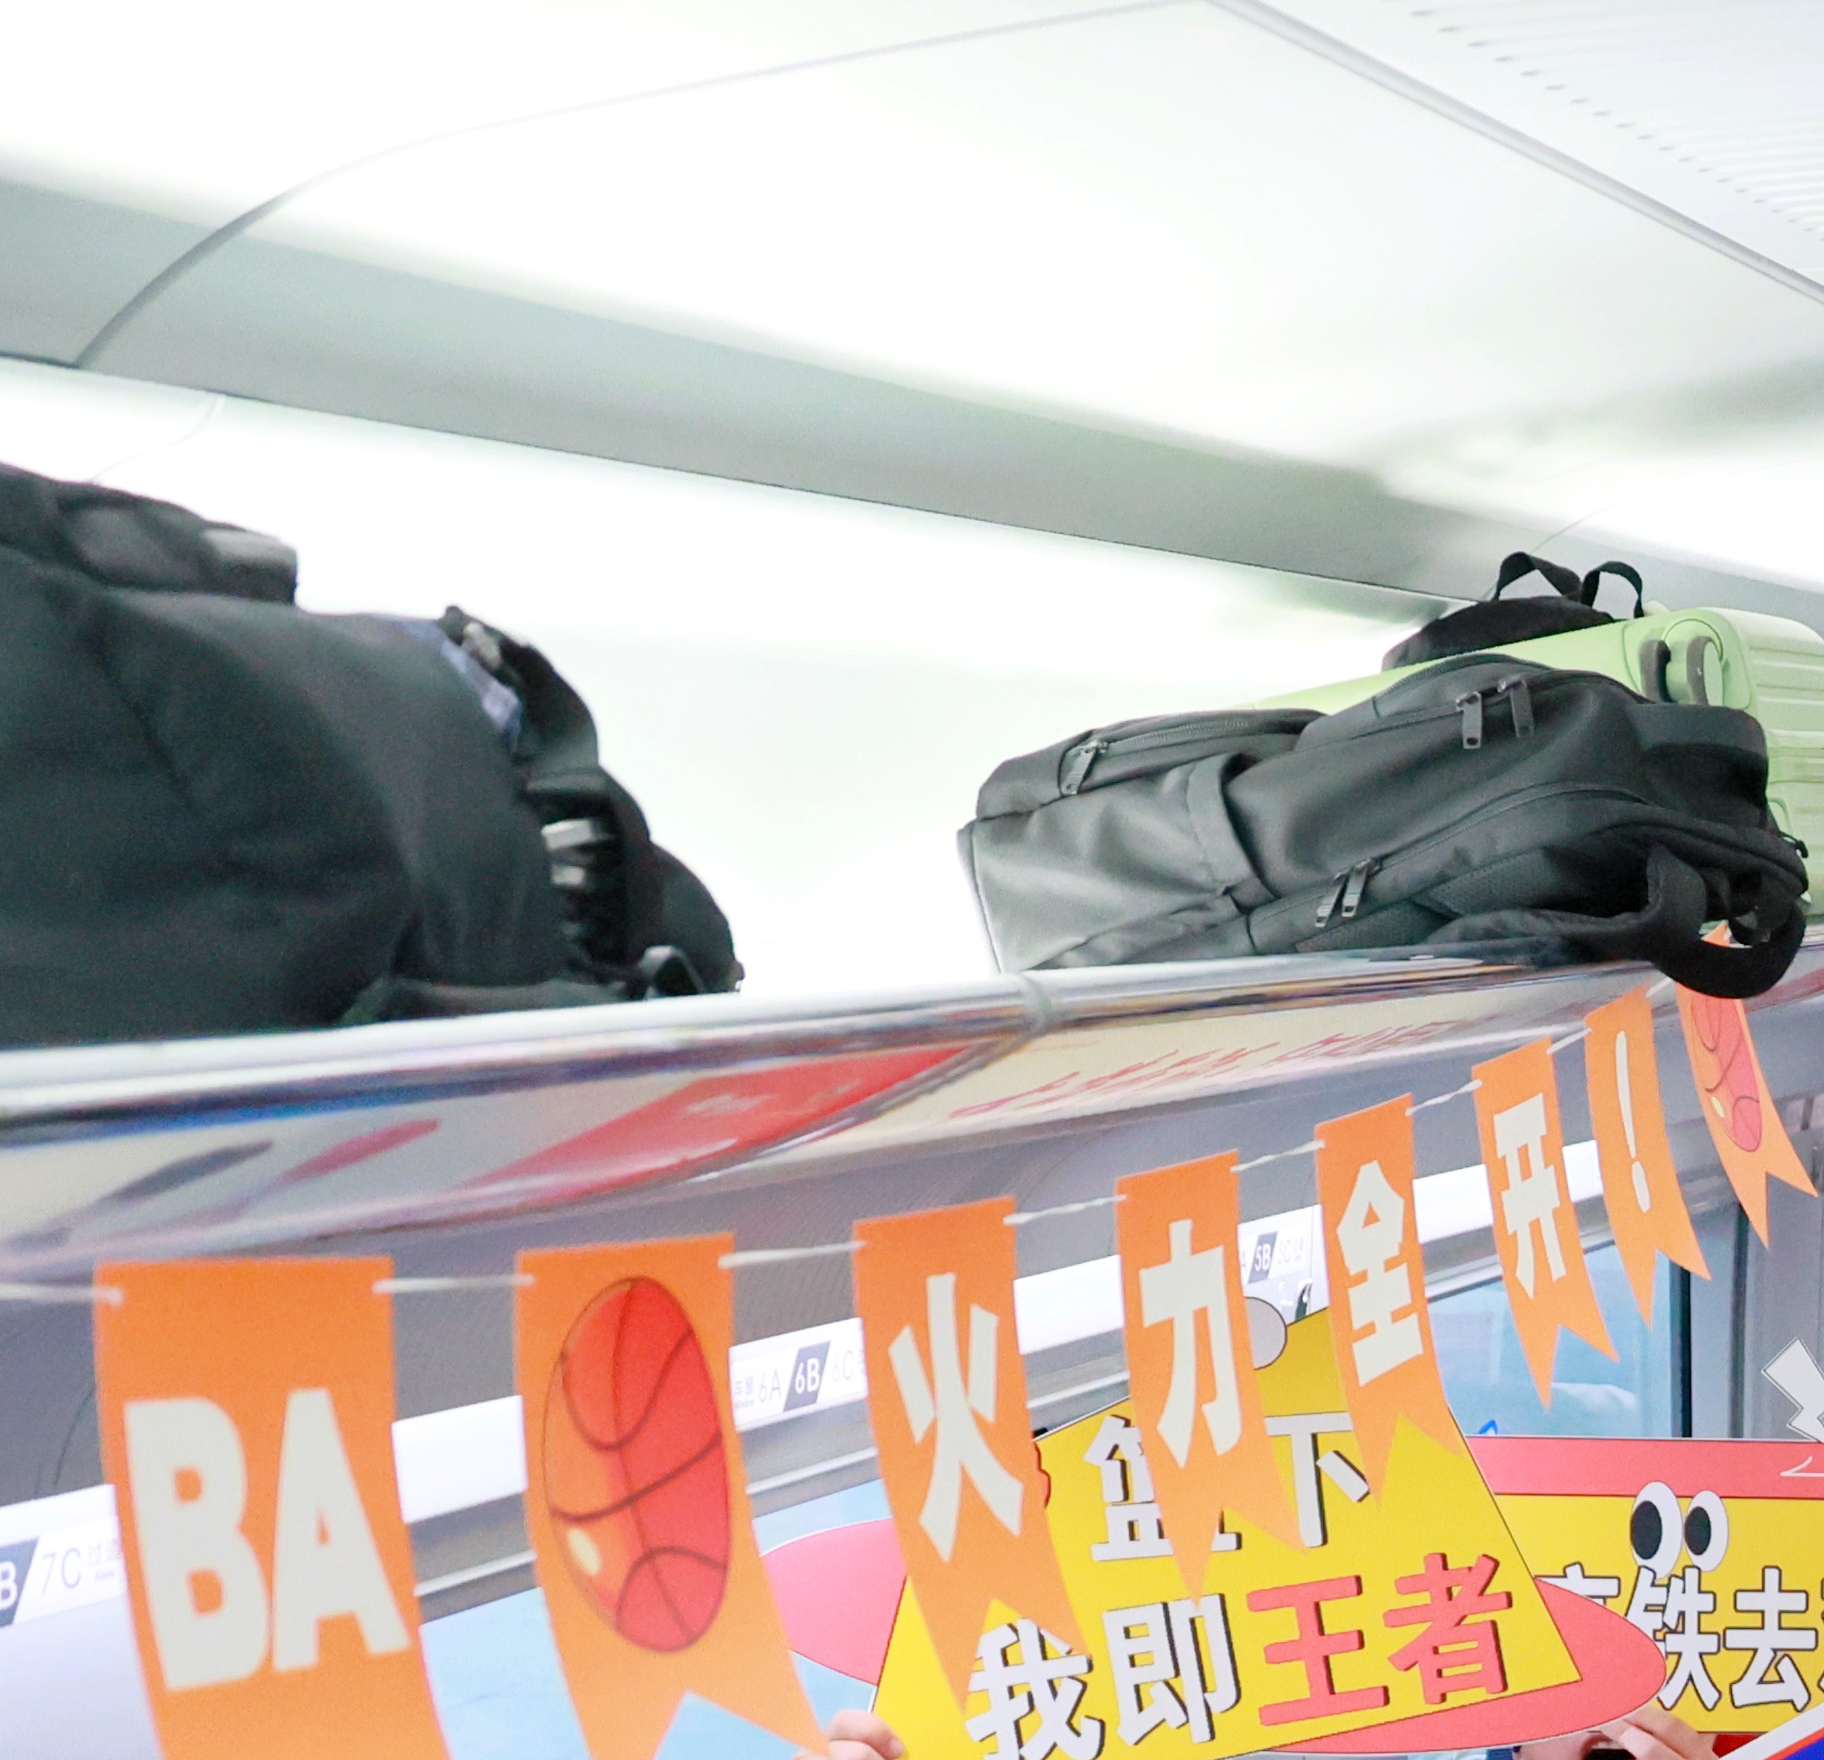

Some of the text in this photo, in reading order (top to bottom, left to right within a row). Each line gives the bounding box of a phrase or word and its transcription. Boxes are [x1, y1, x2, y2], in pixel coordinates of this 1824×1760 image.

[124, 1388, 410, 1692] BA
[889, 1273, 1025, 1563] 火
[1140, 1218, 1243, 1469] 力
[1336, 1160, 1426, 1388] 全
[1494, 1093, 1561, 1301] 开
[794, 1357, 821, 1395] 6B
